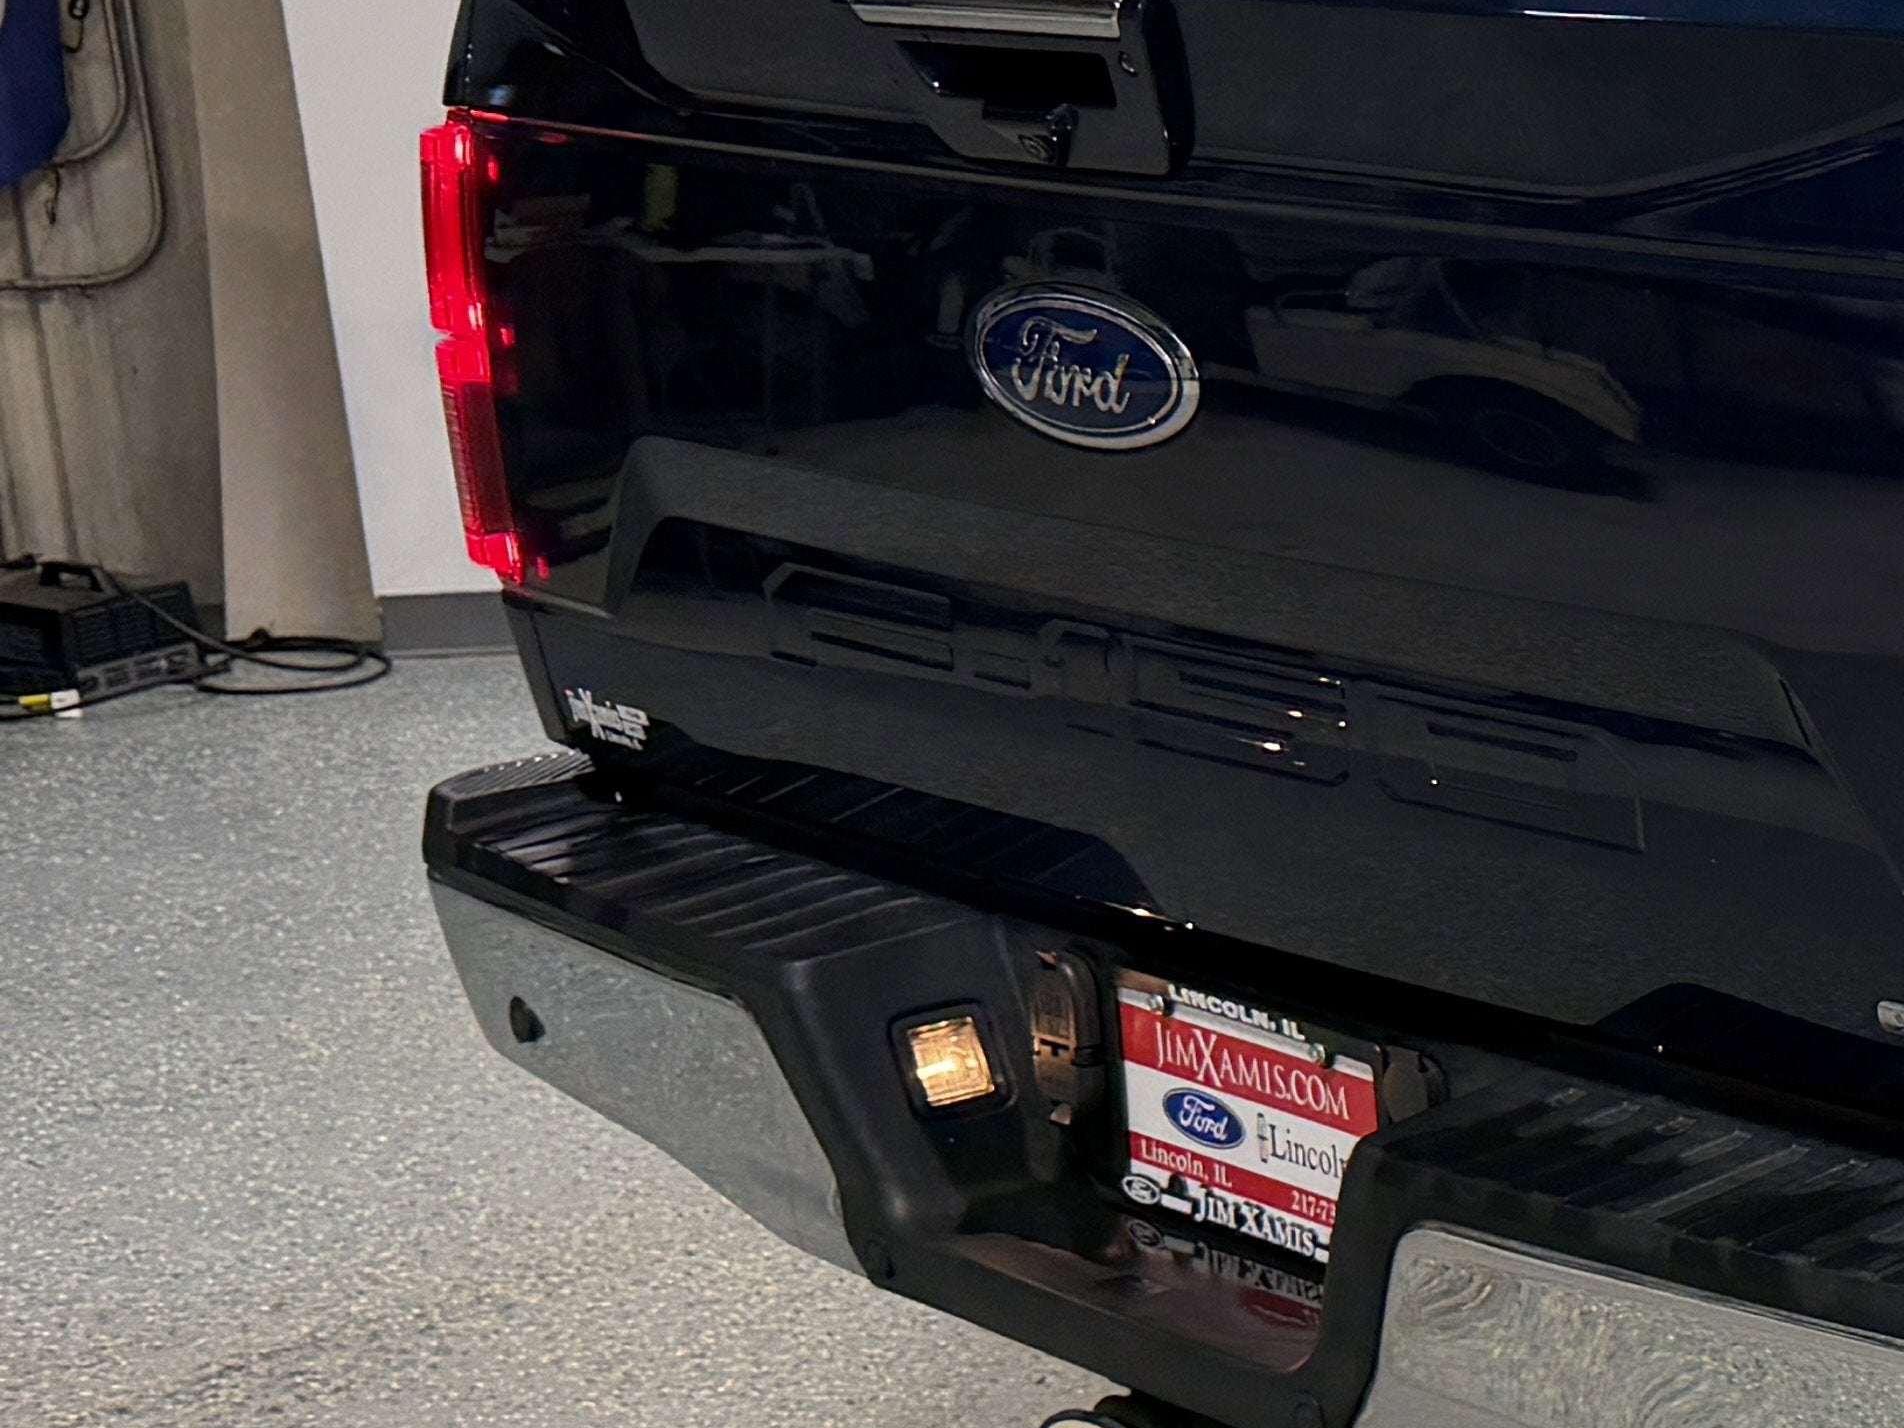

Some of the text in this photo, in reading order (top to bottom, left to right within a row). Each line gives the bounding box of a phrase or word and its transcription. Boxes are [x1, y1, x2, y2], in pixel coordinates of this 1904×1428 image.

[1011, 316, 1131, 414] Ford
[1178, 1094, 1229, 1142] Ford
[1211, 1164, 1233, 1188] IL
[1194, 1188, 1236, 1229] JIM
[1238, 1200, 1317, 1258] XAMIS
